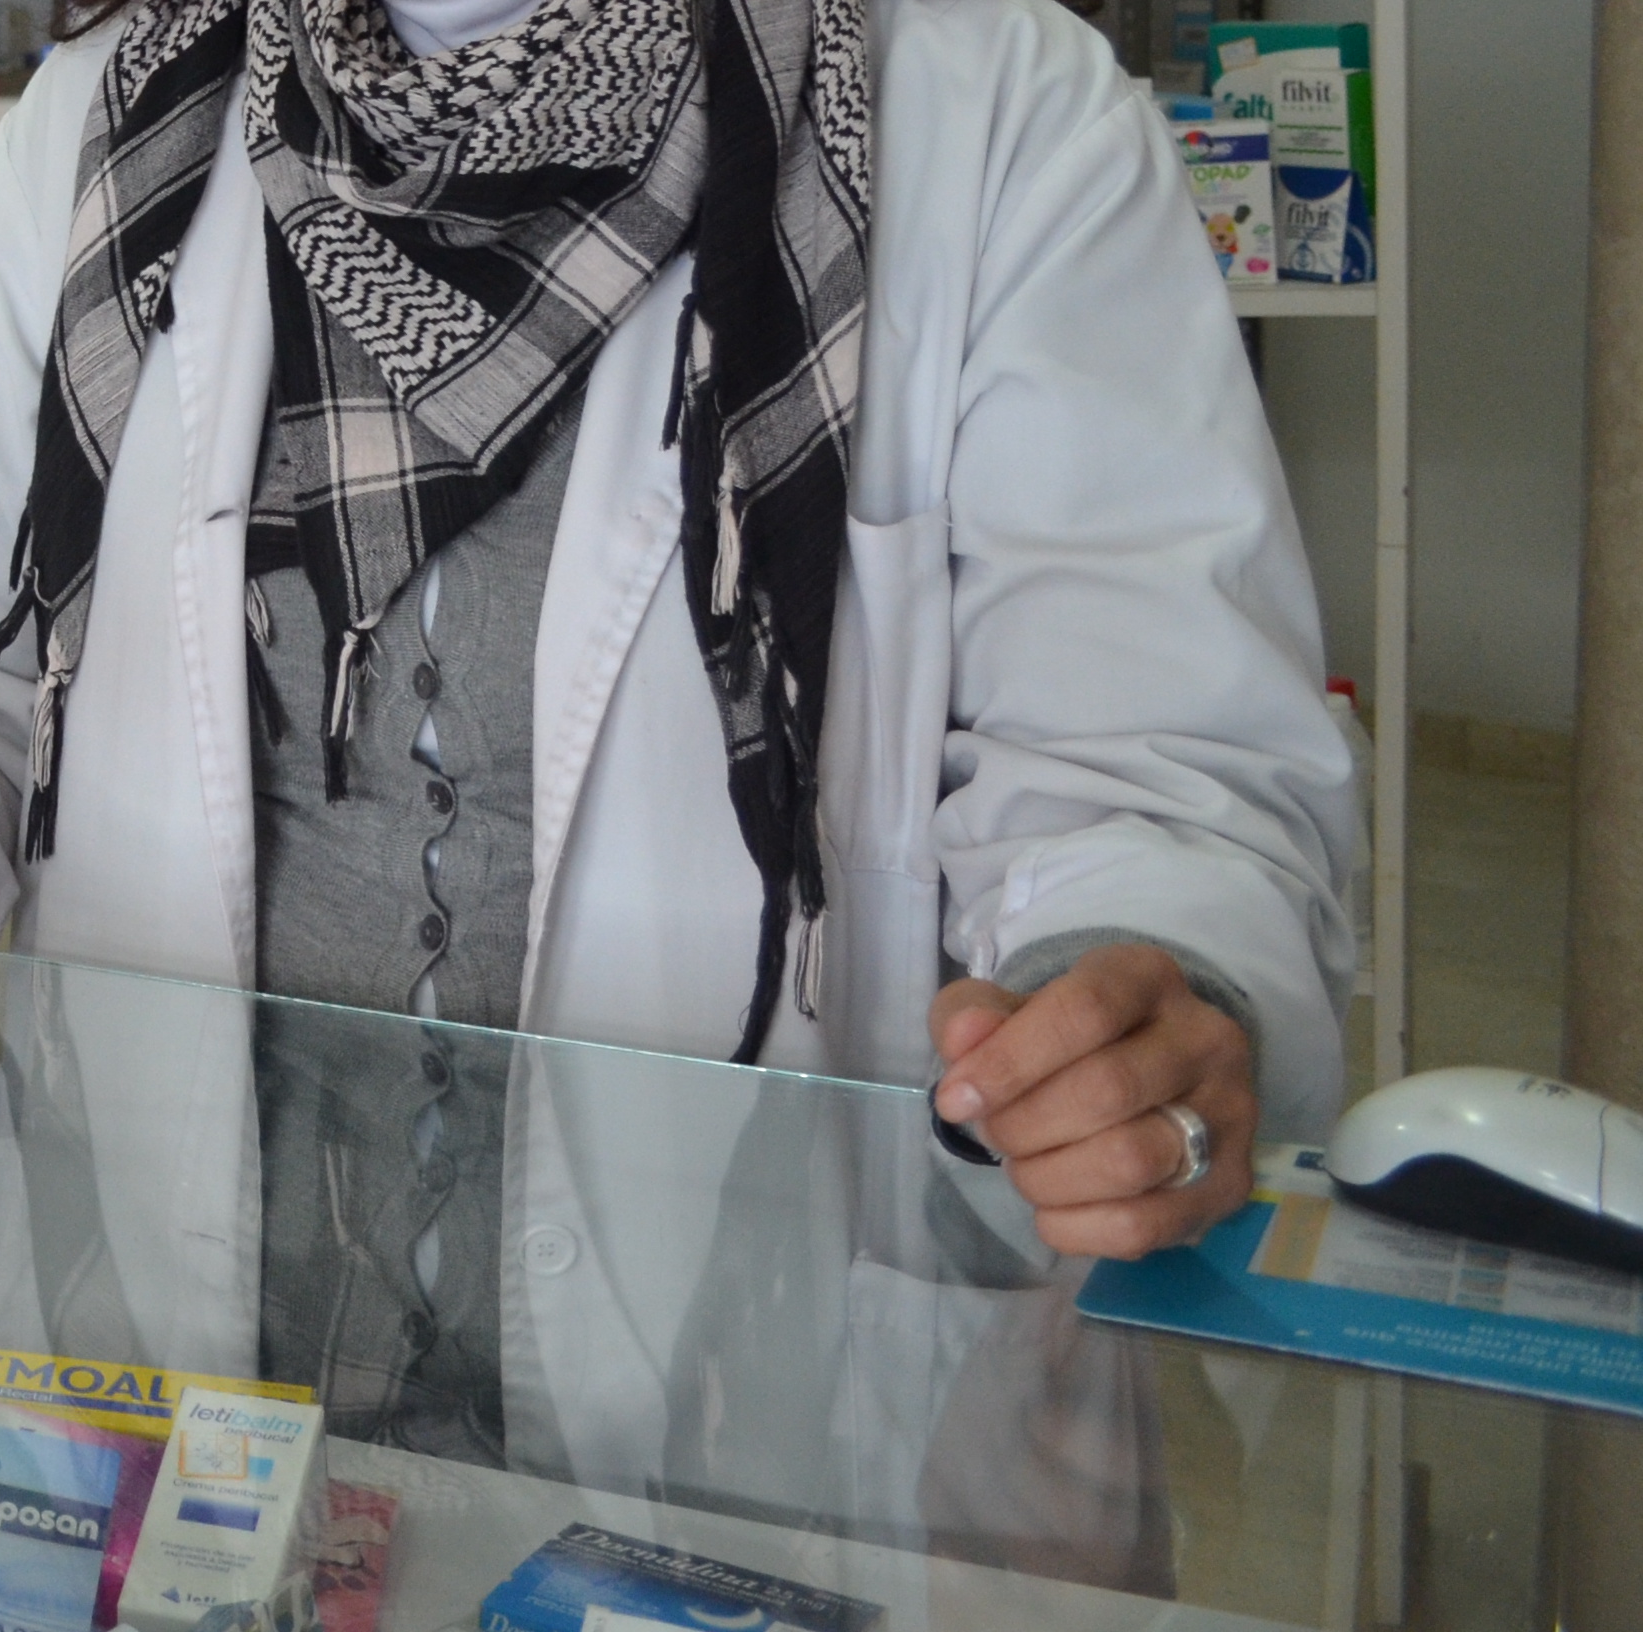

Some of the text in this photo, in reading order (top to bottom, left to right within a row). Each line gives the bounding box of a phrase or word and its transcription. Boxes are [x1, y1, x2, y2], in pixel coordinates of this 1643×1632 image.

[0, 1387, 54, 1404] Rectal
[187, 1400, 303, 1437] letibalm
[221, 1423, 298, 1447] peribucal
[172, 1476, 280, 1503] Crema peribucal
[567, 1527, 761, 1592] Dormidina
